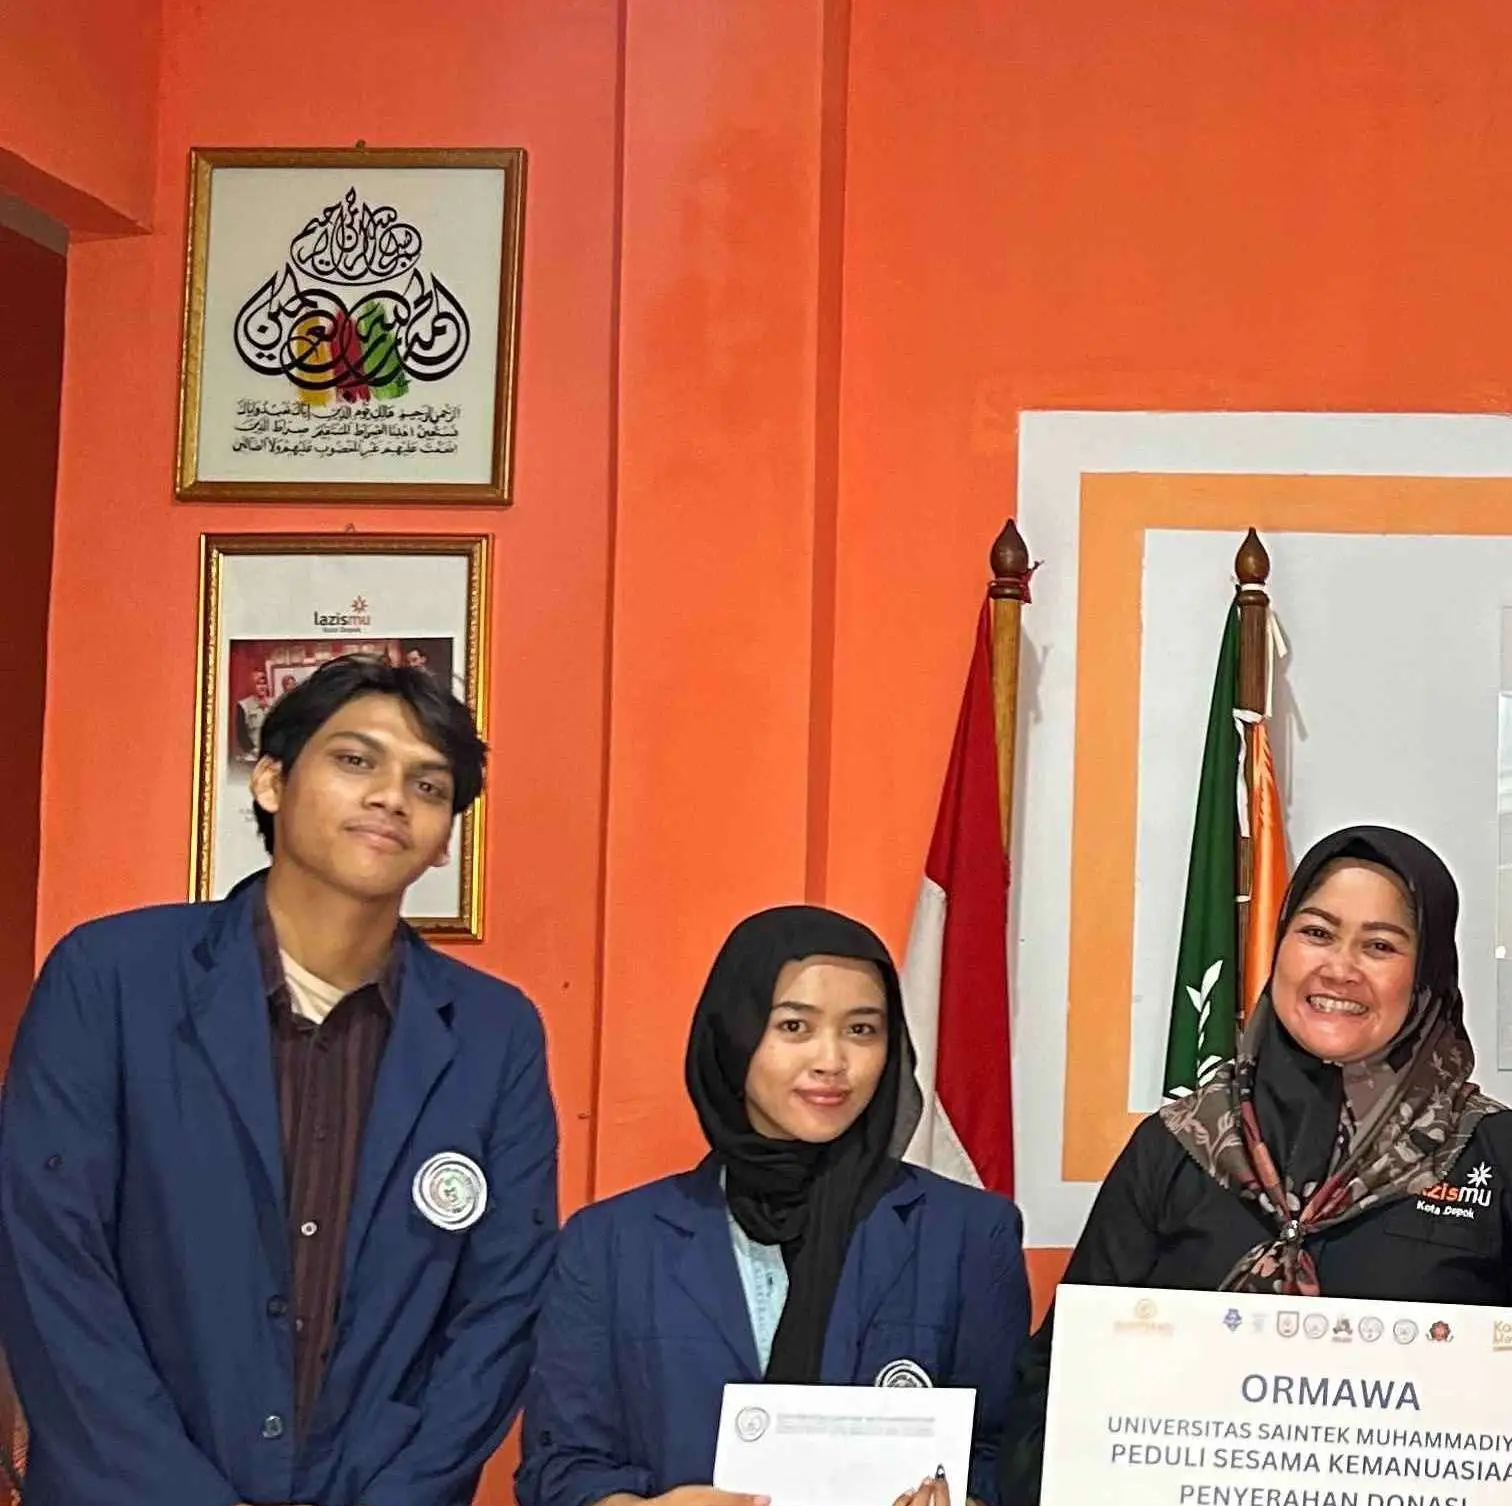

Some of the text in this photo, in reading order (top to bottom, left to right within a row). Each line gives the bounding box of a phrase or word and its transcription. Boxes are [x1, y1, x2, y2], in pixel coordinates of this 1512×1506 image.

[314, 611, 371, 626] lazismu
[1416, 1200, 1475, 1219] Kota Depok
[1241, 1374, 1420, 1411] ORMAWA
[1107, 1416, 1253, 1440] UNIVERSITAS
[1257, 1422, 1350, 1445] SAINTEK
[1111, 1443, 1206, 1469] PEDULI
[1213, 1447, 1320, 1473] SESAMA
